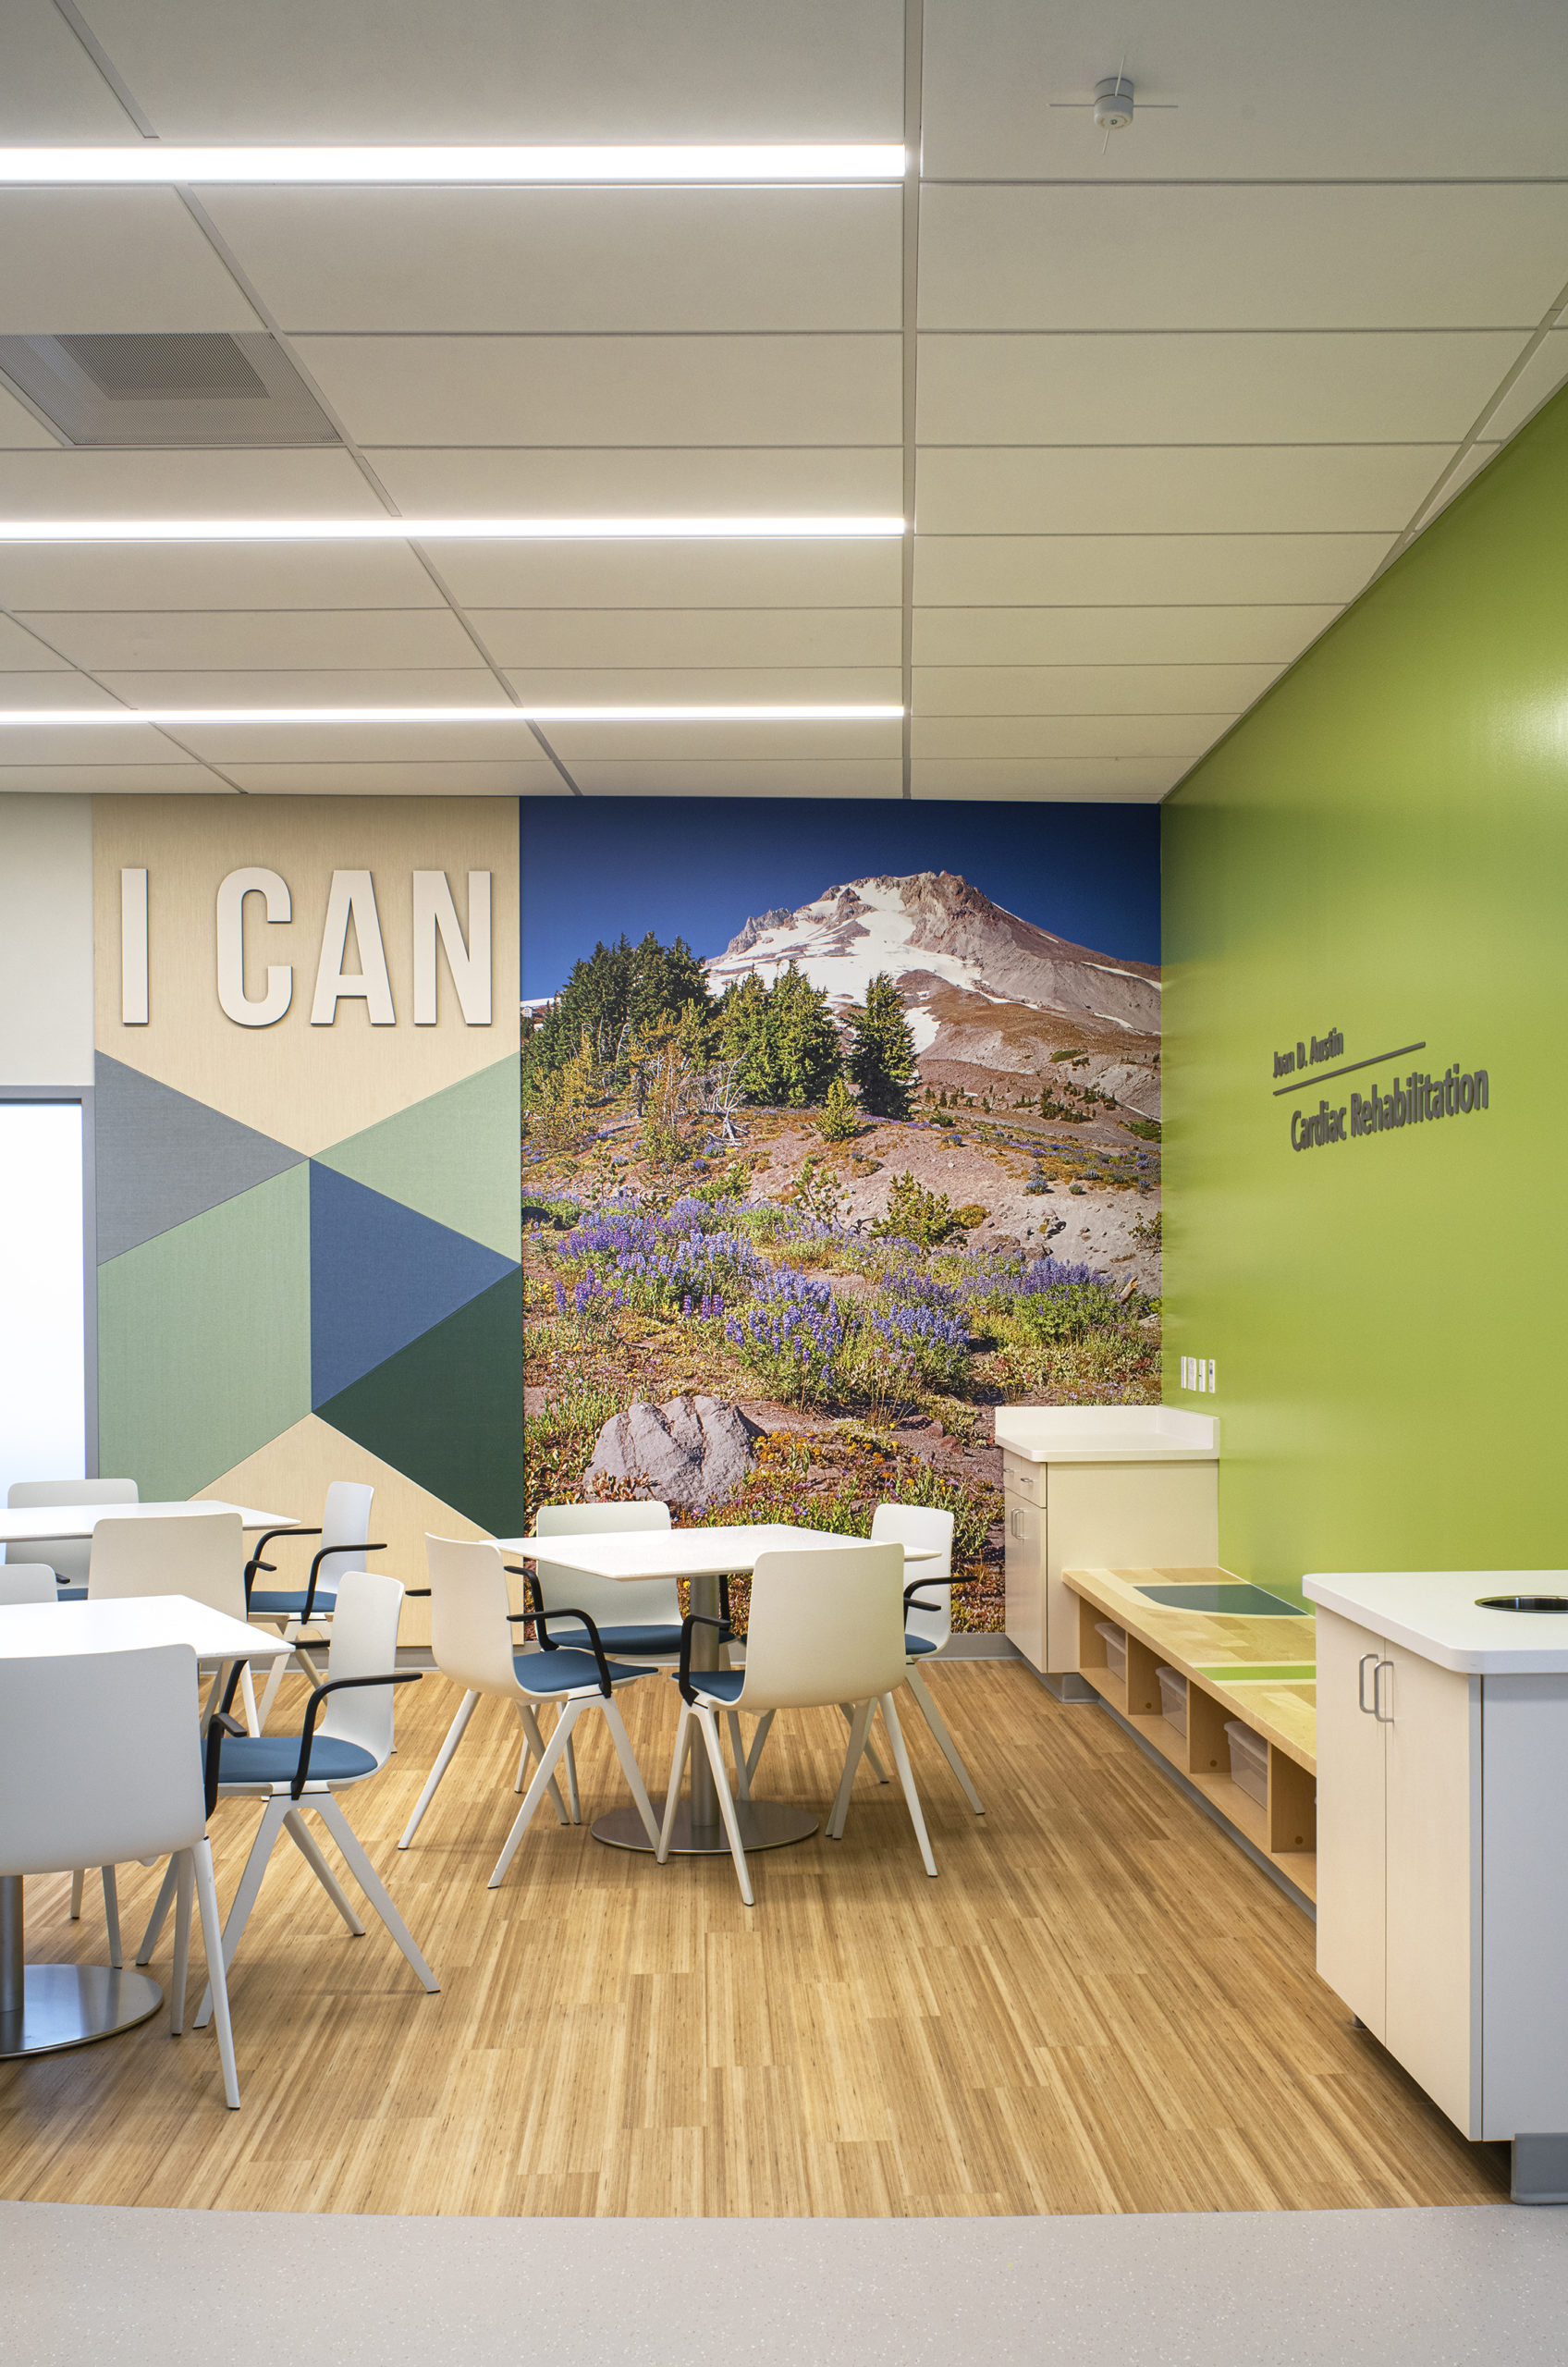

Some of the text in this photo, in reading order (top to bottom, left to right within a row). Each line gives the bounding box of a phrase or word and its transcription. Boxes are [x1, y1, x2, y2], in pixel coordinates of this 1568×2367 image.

[120, 866, 493, 1027] I CAN
[1296, 1041, 1308, 1070] D.
[1309, 1026, 1344, 1065] Austin
[1291, 1063, 1489, 1152] Cardiac Rehabilitation
